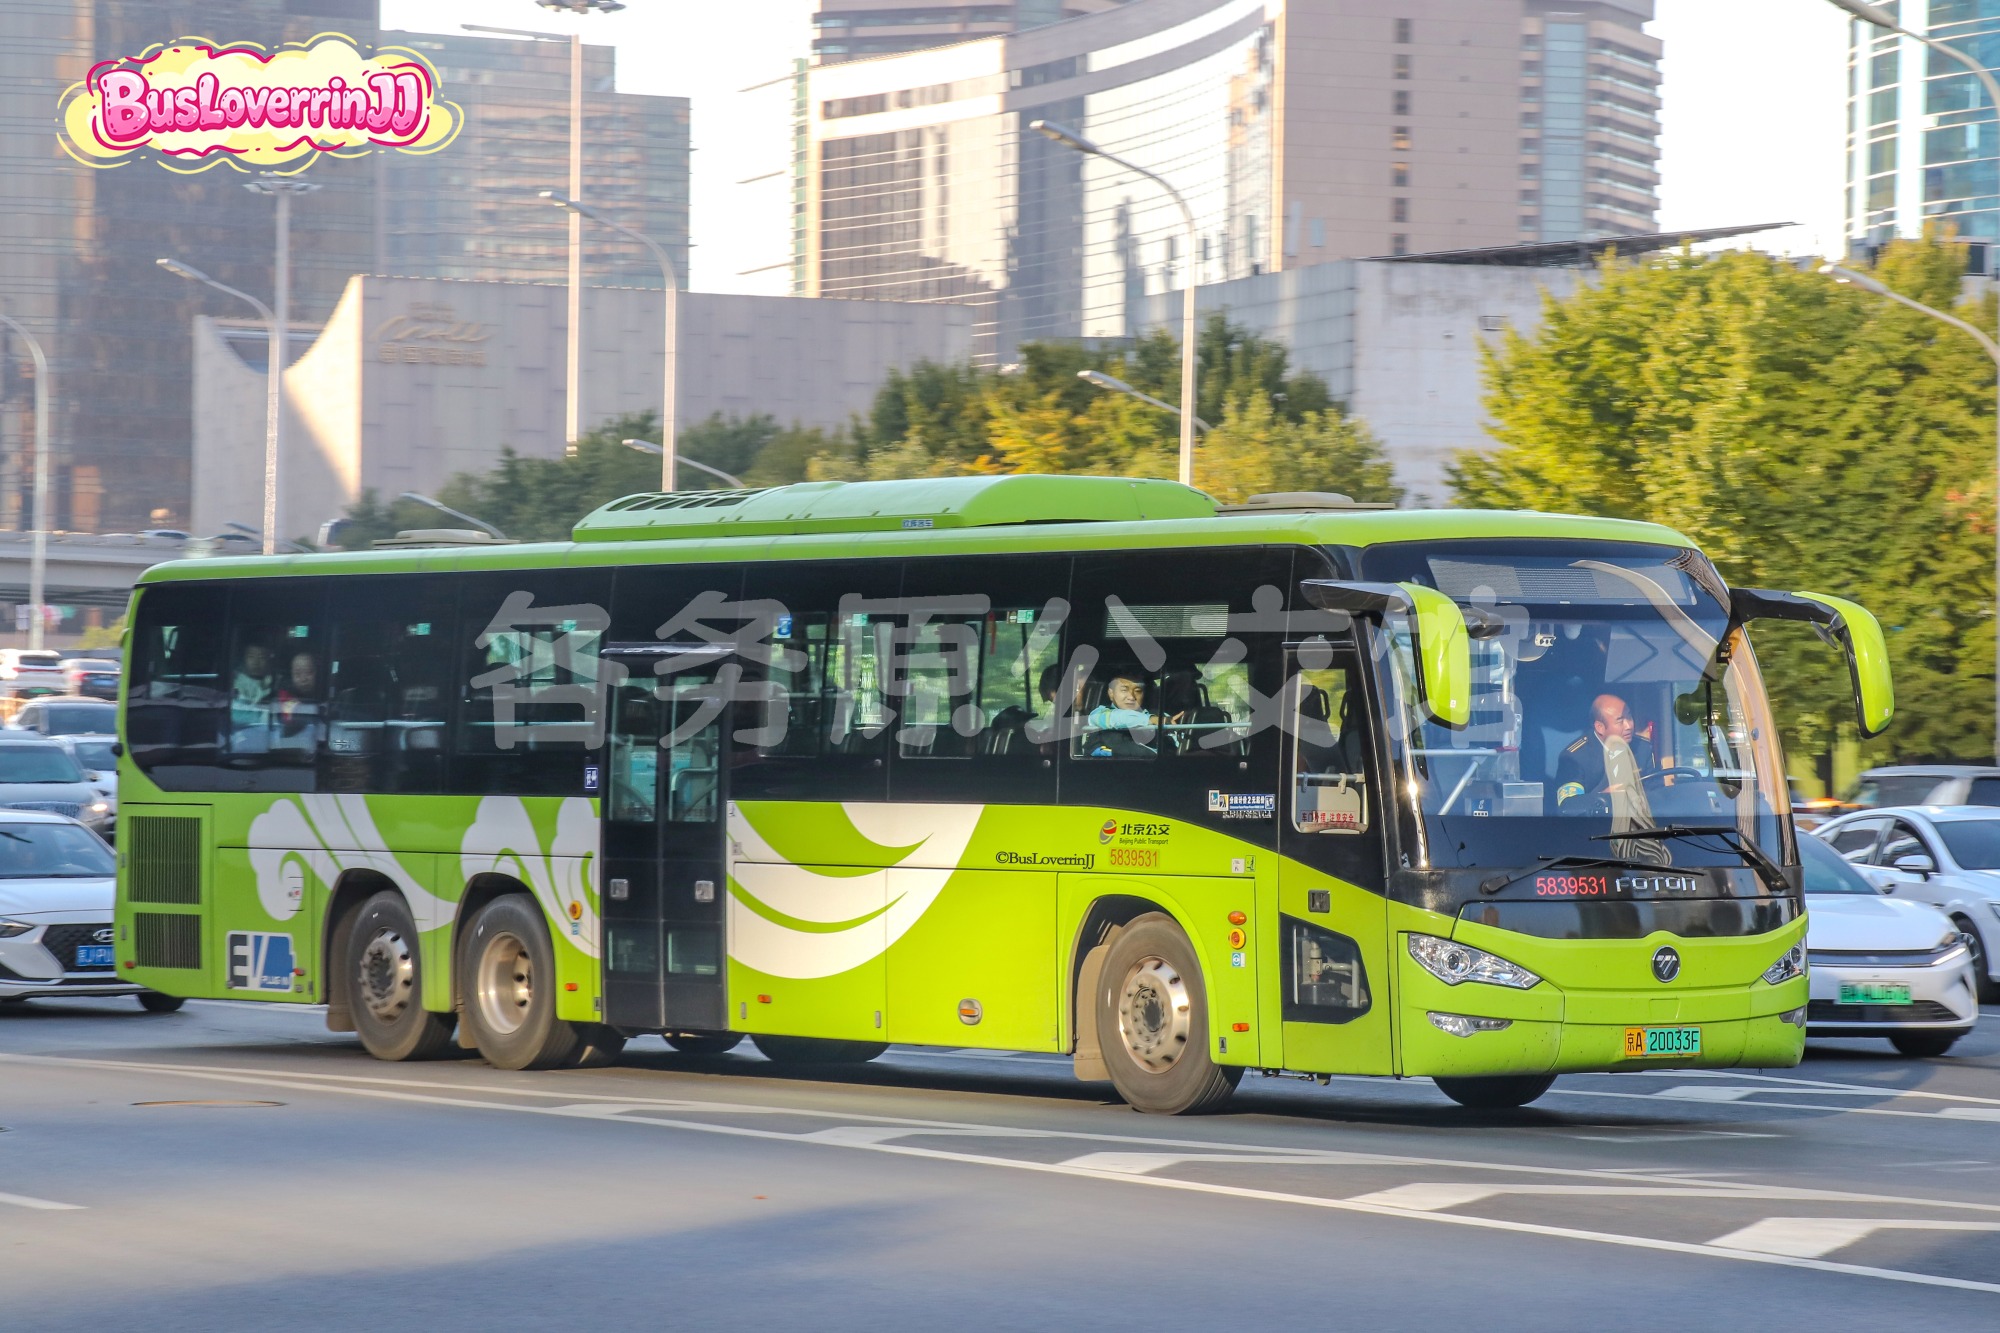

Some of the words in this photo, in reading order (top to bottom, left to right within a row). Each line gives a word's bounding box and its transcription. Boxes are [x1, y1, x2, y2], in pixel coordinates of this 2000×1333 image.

[1120, 823, 1171, 836] 北京公交
[1119, 837, 1133, 845] Beijing
[1134, 837, 1147, 845] Public
[1148, 838, 1169, 846] Transport
[1110, 848, 1158, 867] 5839531
[1536, 876, 1607, 896] 5839531
[1627, 1032, 1643, 1051] 京A
[1649, 1030, 1699, 1051] 20033F
